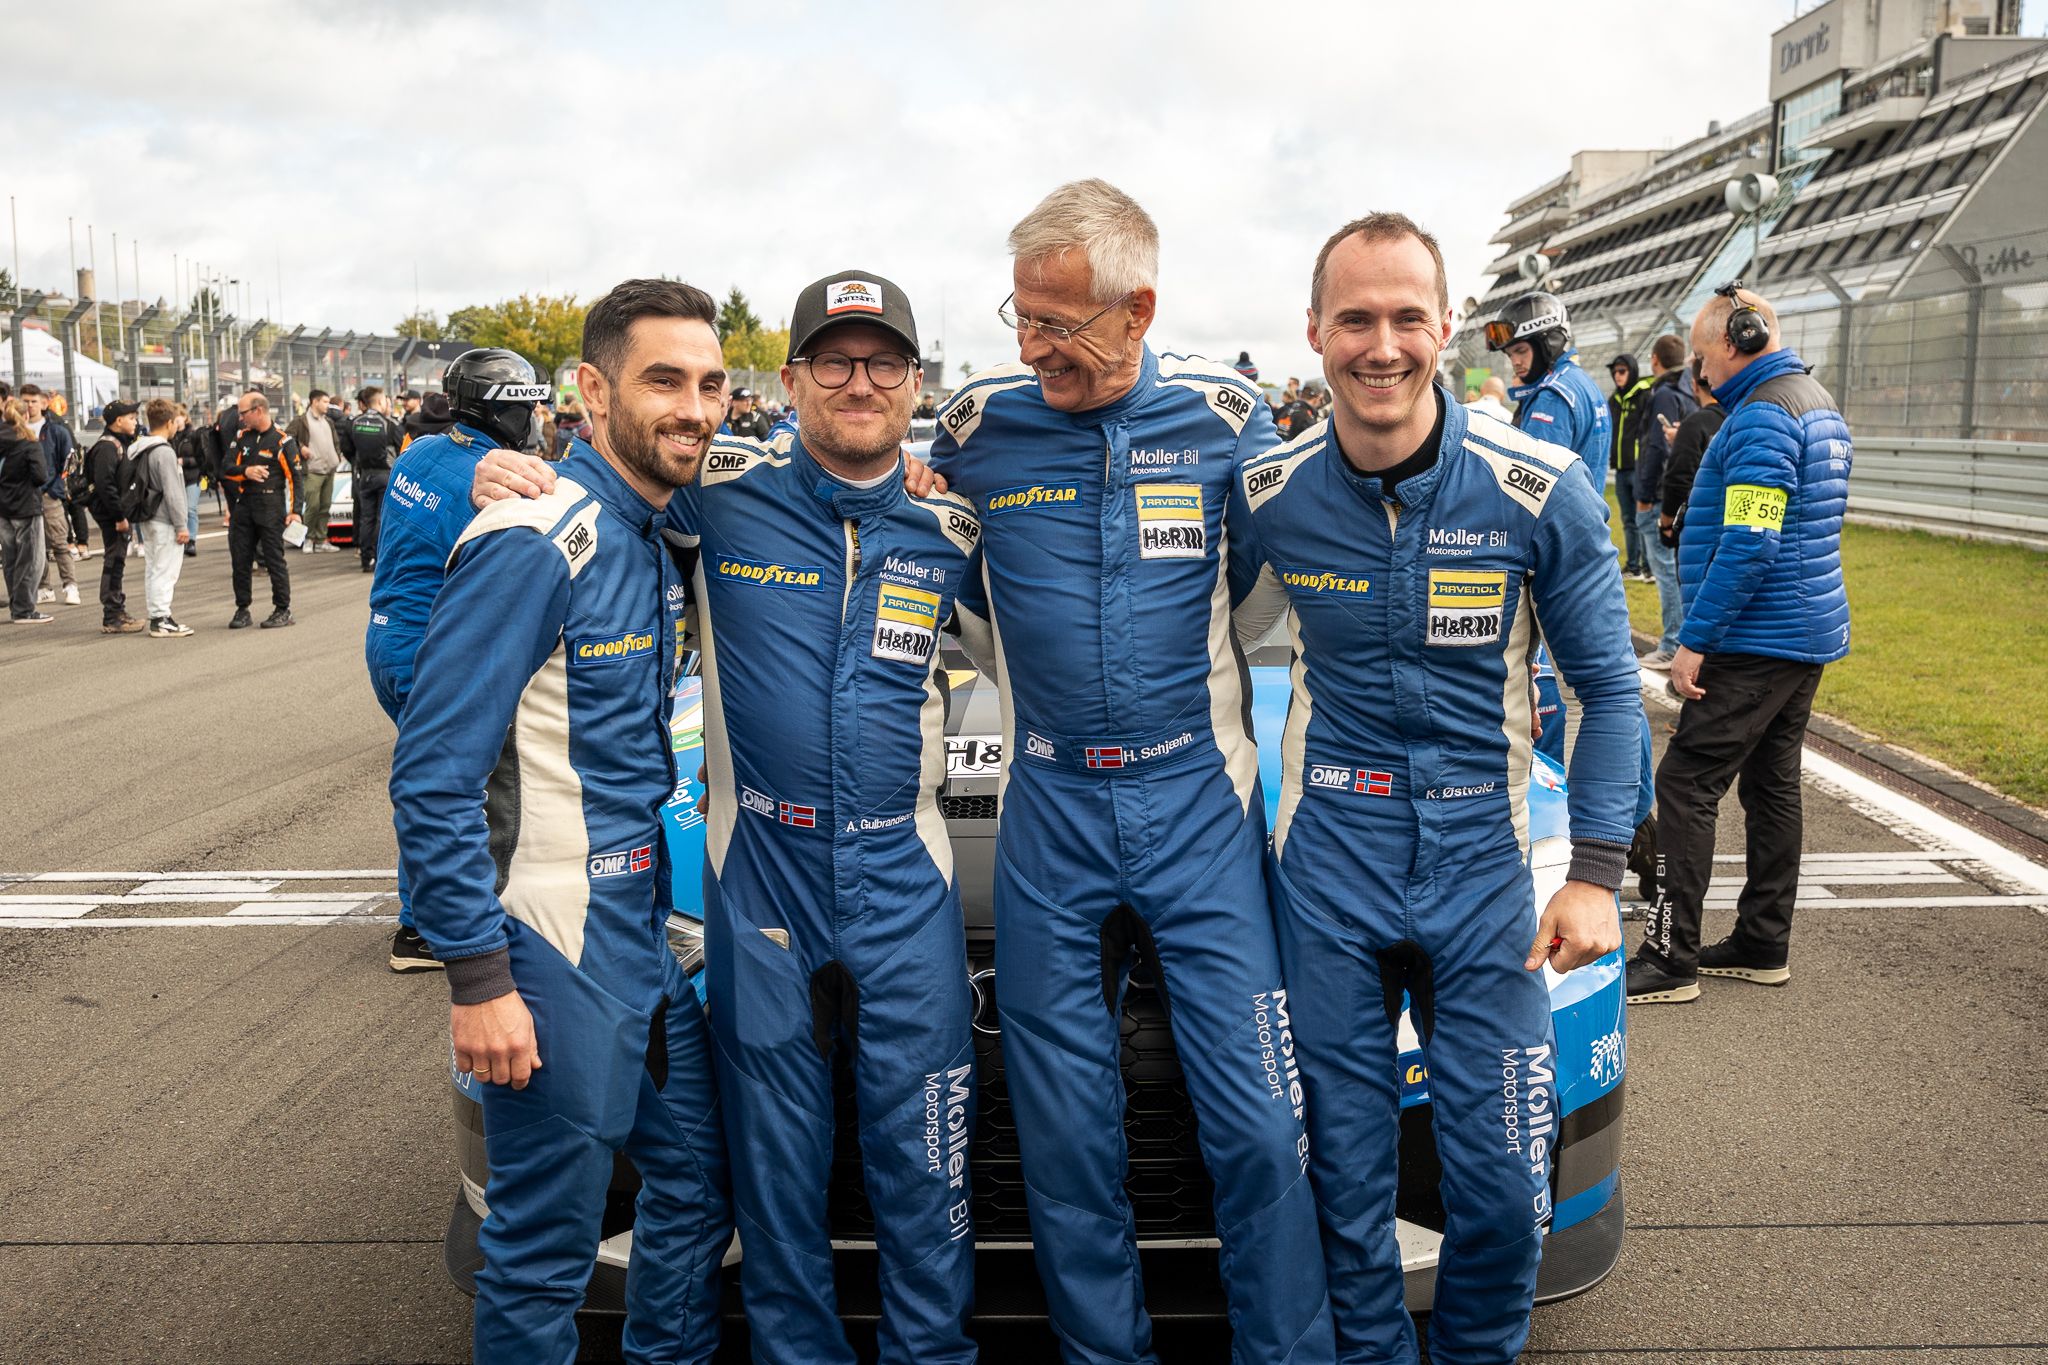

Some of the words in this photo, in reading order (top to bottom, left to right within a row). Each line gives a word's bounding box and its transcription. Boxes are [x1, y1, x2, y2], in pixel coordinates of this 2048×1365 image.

[1522, 315, 1559, 332] uvex
[506, 388, 546, 397] uvex
[1217, 390, 1249, 416] OMP
[947, 398, 975, 429] OMP
[708, 455, 747, 469] OMP
[1184, 449, 1199, 465] Bil
[1130, 466, 1172, 475] Motorsport
[1248, 468, 1283, 493] OMP
[1507, 468, 1547, 495] OMP
[423, 491, 442, 512] Bil
[1146, 498, 1195, 507] RAVENOL
[1755, 491, 1770, 500] PIT
[949, 515, 978, 539] OMP
[568, 526, 589, 556] OMP
[1489, 530, 1508, 547] Bil
[1426, 547, 1473, 557] Motorsport
[879, 571, 920, 587] Motorsport
[932, 568, 946, 584] Bil
[1439, 585, 1496, 594] RAVENOL
[888, 599, 932, 615] RAVENOL
[1026, 737, 1055, 757] OMP
[1123, 750, 1138, 763] H.
[1310, 768, 1351, 786] OMP
[742, 790, 775, 814] OMP
[1426, 789, 1440, 800] K.
[846, 821, 859, 833] A.
[590, 855, 626, 875] OMP
[1252, 992, 1285, 1100] Motorsport
[1406, 1064, 1429, 1085] G
[1501, 1048, 1523, 1156] Motorsport
[923, 1072, 942, 1173] Motorsport
[950, 1199, 970, 1242] Bil
